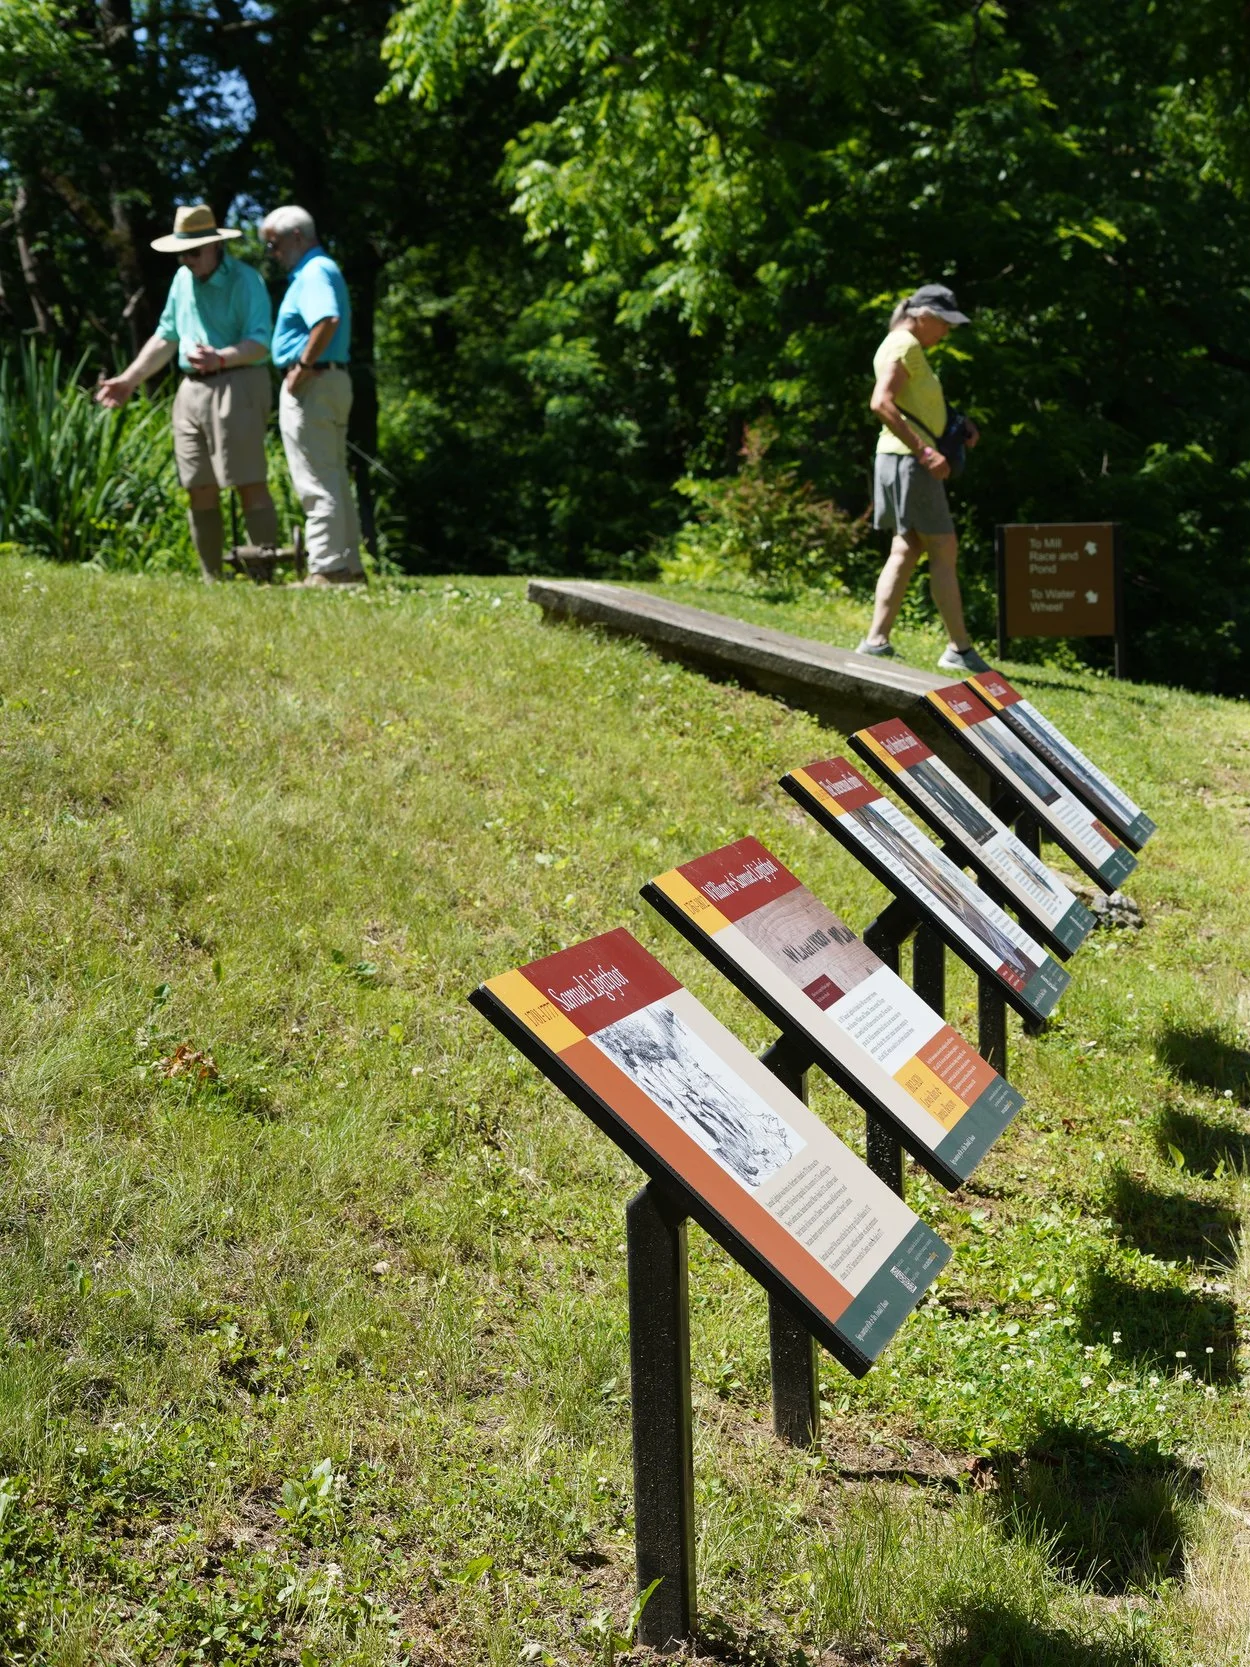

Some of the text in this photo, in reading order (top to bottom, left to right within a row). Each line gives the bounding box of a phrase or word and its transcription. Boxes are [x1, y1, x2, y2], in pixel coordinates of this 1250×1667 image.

[1029, 538, 1062, 549] To Mill
[1029, 551, 1079, 561] Race and
[1029, 564, 1057, 574] Pond
[1030, 588, 1076, 599] To Water
[1030, 602, 1064, 612] Wheel
[701, 880, 734, 902] William
[729, 864, 757, 888] Samuel
[747, 857, 779, 883] Lightfoot
[548, 964, 629, 1012] Samuel Lightfoot
